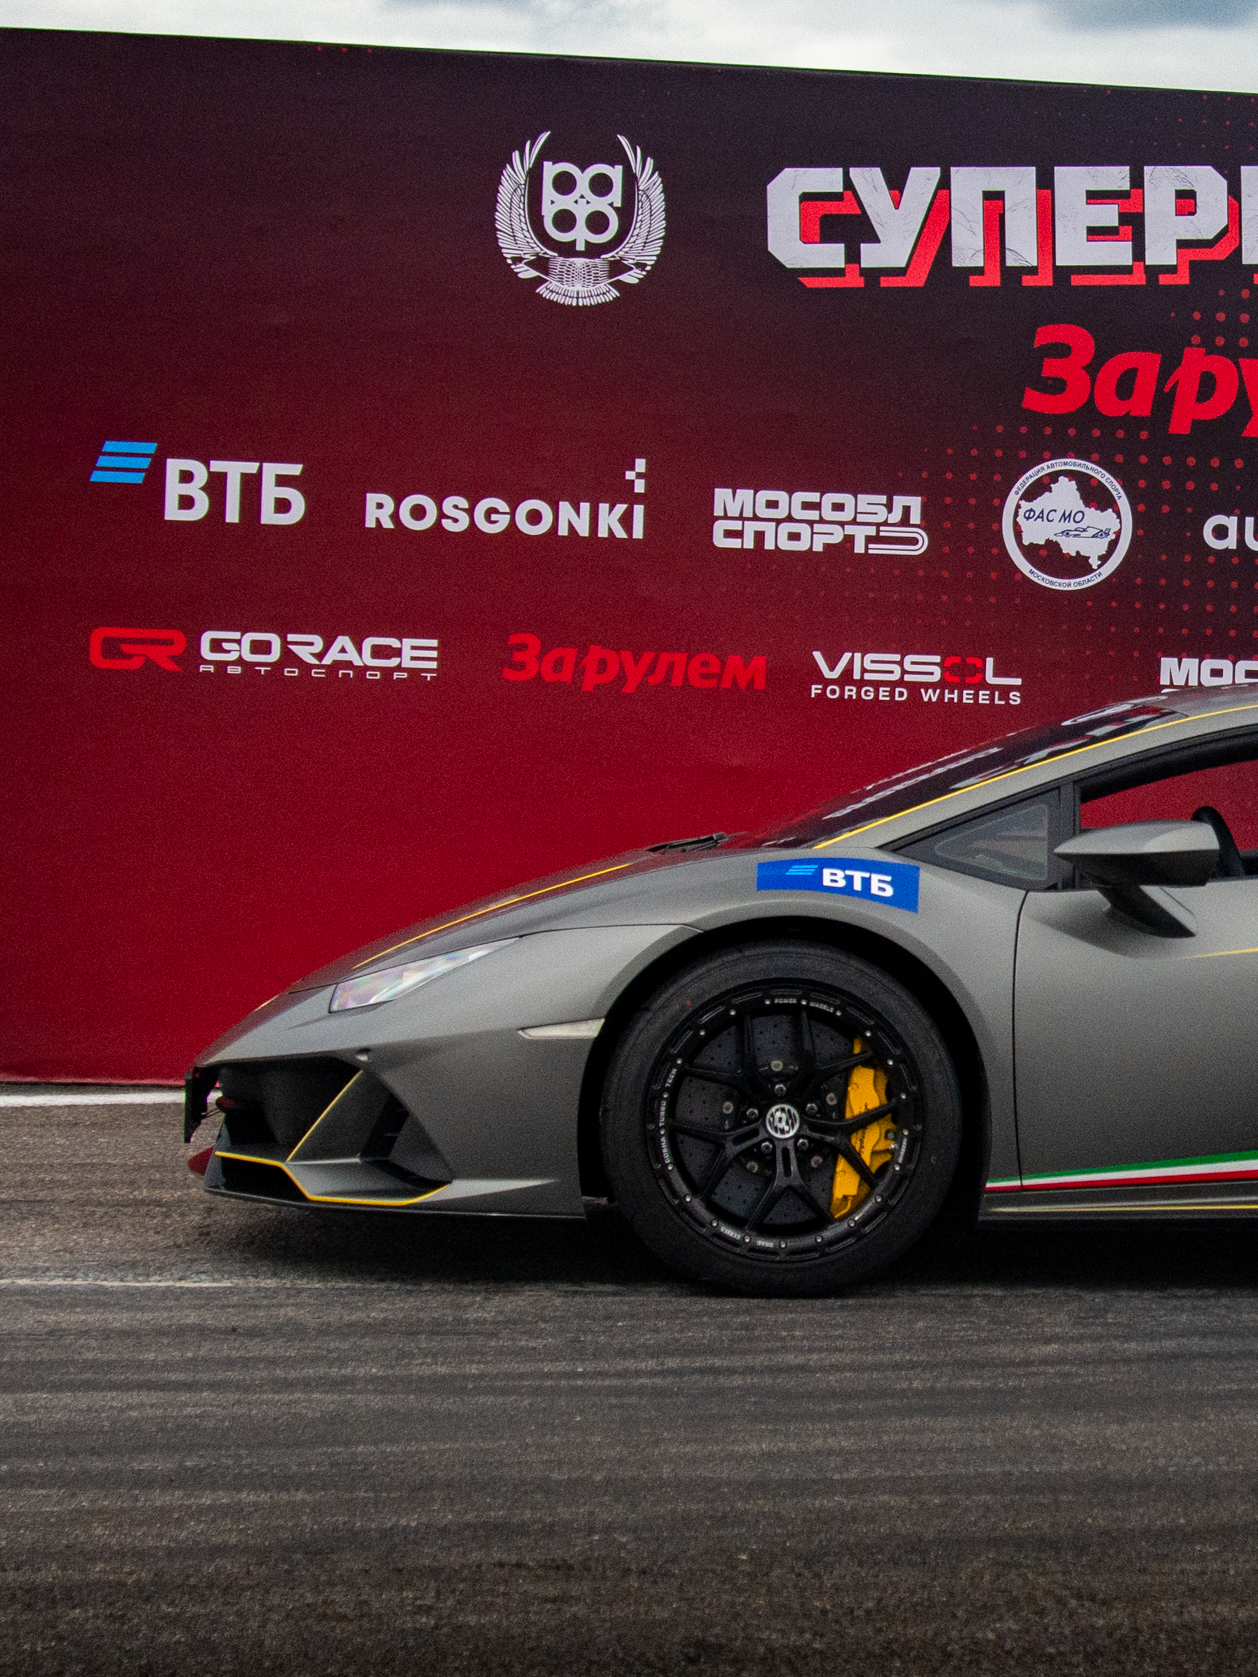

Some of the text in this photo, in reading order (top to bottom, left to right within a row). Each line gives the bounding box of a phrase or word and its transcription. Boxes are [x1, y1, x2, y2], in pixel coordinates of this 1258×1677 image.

[164, 457, 306, 526] ВТБ
[1014, 461, 1122, 500] ФЕДЕРАЦИЯ АВТОМОБИЛЬНОГО СПОРТА
[365, 492, 645, 540] ROSGONKI
[713, 487, 922, 525] МОСОБЛ
[1023, 507, 1085, 524] ФАС МО
[712, 519, 877, 554] СПОРТ
[1028, 568, 1103, 588] МОСКОВСКОЙ ОБЛАСТИ
[199, 664, 438, 681] АВТОСПОРТ
[811, 650, 1022, 686] VISSOL
[810, 683, 1022, 705] FORGED WHEELS
[822, 867, 894, 898] ВТБ
